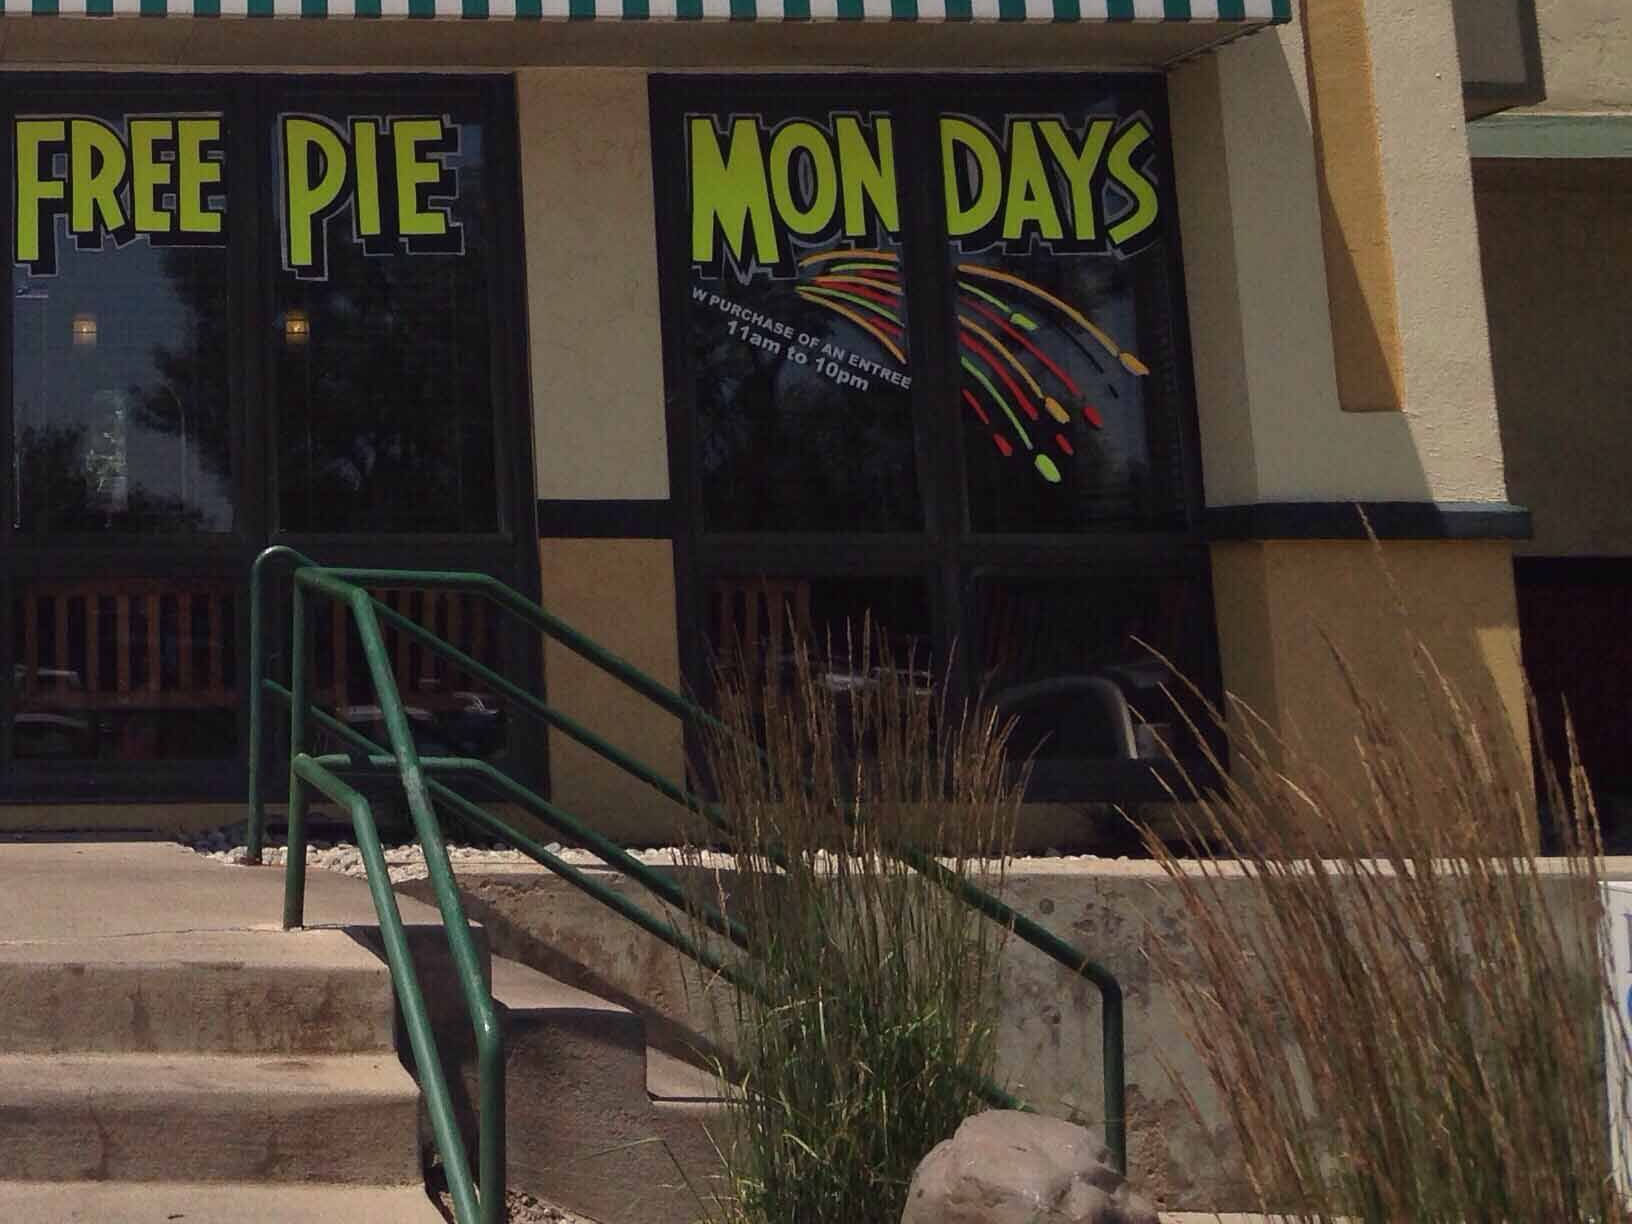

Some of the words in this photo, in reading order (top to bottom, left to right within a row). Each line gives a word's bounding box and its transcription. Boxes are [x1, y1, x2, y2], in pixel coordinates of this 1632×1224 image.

[15, 117, 224, 264] FREE
[283, 117, 453, 271] PIE
[688, 115, 902, 268] MON
[939, 115, 1161, 250] DAYS
[709, 295, 795, 339] PURCHASE
[798, 332, 820, 349] OF
[821, 343, 846, 361] AN
[848, 353, 913, 390] ENTREE
[727, 320, 781, 355] 11am
[786, 344, 809, 365] to
[815, 357, 870, 393] 10pm
